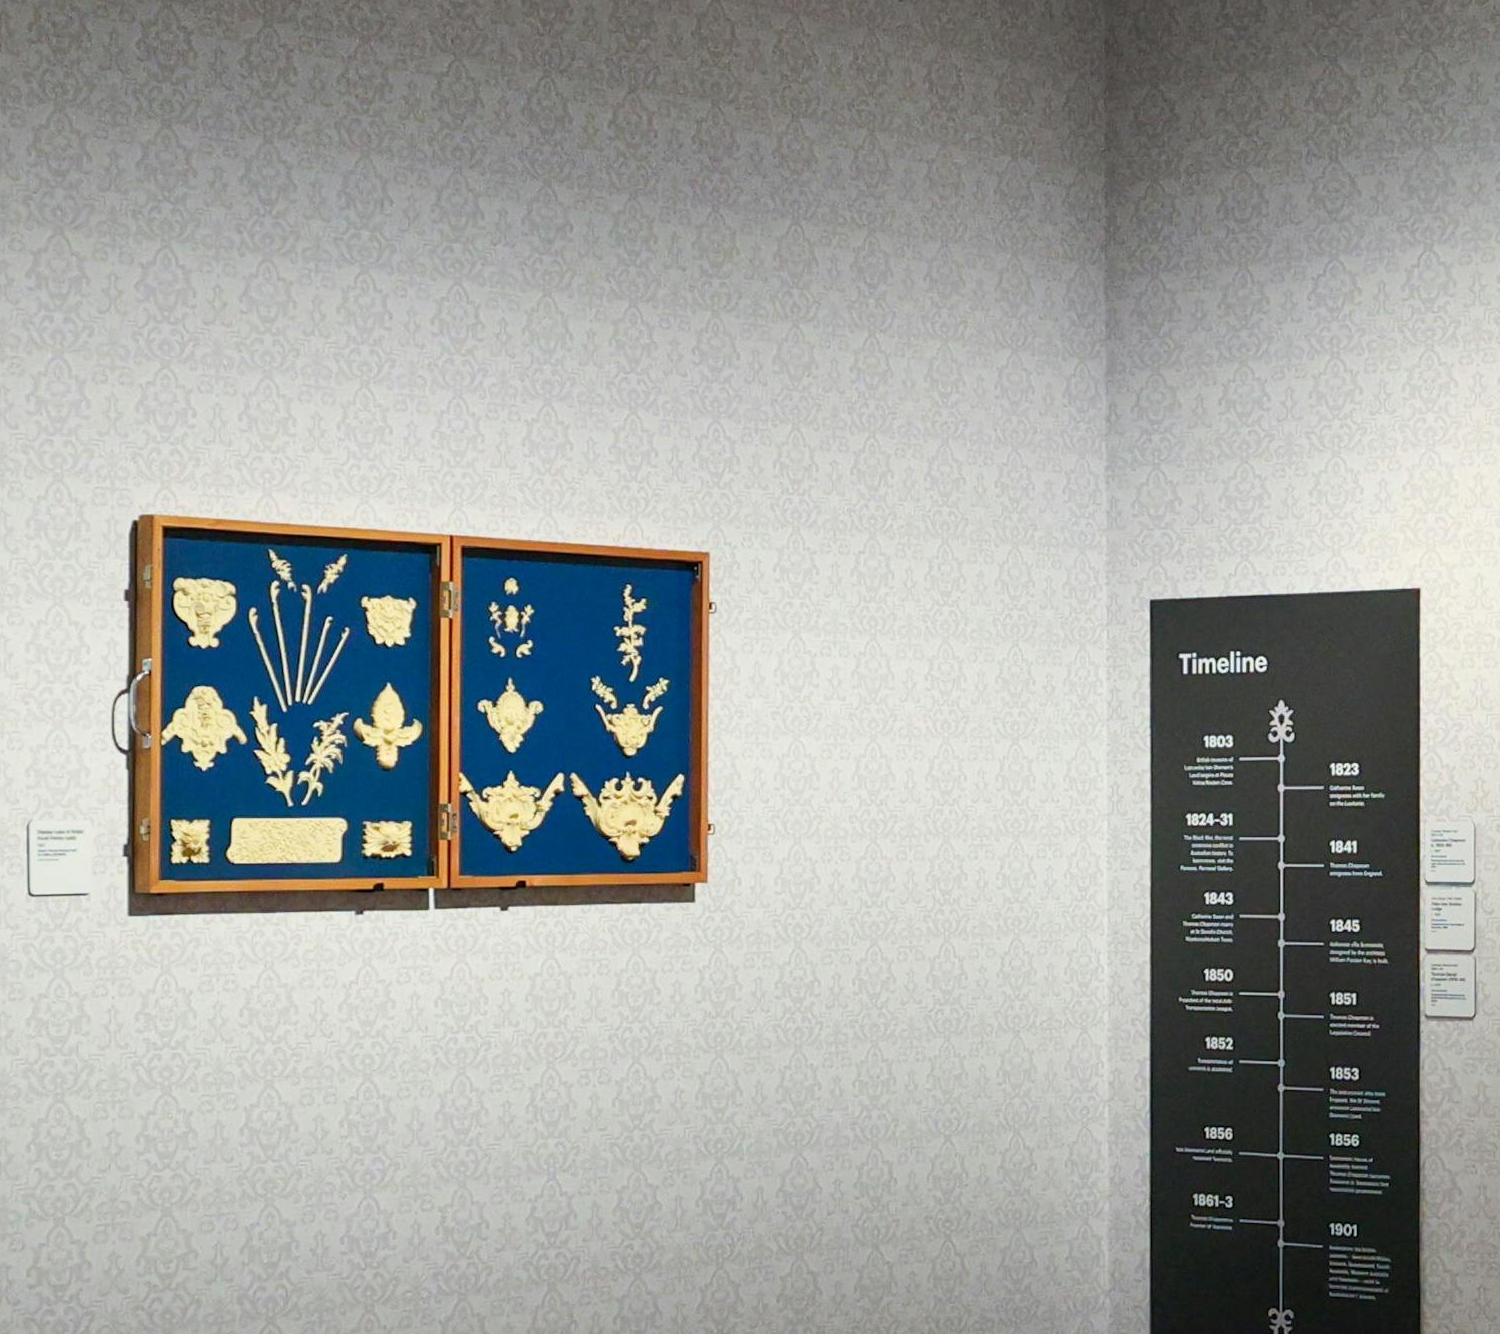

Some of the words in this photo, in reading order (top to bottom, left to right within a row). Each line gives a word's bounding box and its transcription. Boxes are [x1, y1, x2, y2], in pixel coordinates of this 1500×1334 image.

[1179, 651, 1267, 674] Timeline
[1204, 735, 1233, 748] 1803
[1330, 763, 1359, 776] 1823
[1330, 840, 1357, 853] 1841
[1204, 892, 1233, 905] 1843
[1330, 920, 1360, 932] 1845
[1204, 969, 1233, 981] 1850
[1330, 993, 1356, 1005] 1851
[1206, 1037, 1233, 1049] 1852
[1330, 1067, 1359, 1080] 1853
[1205, 1127, 1232, 1139] 1856
[1330, 1134, 1359, 1146] 1856
[1193, 1194, 1232, 1207] 1861-3
[1330, 1224, 1357, 1236] 1901
